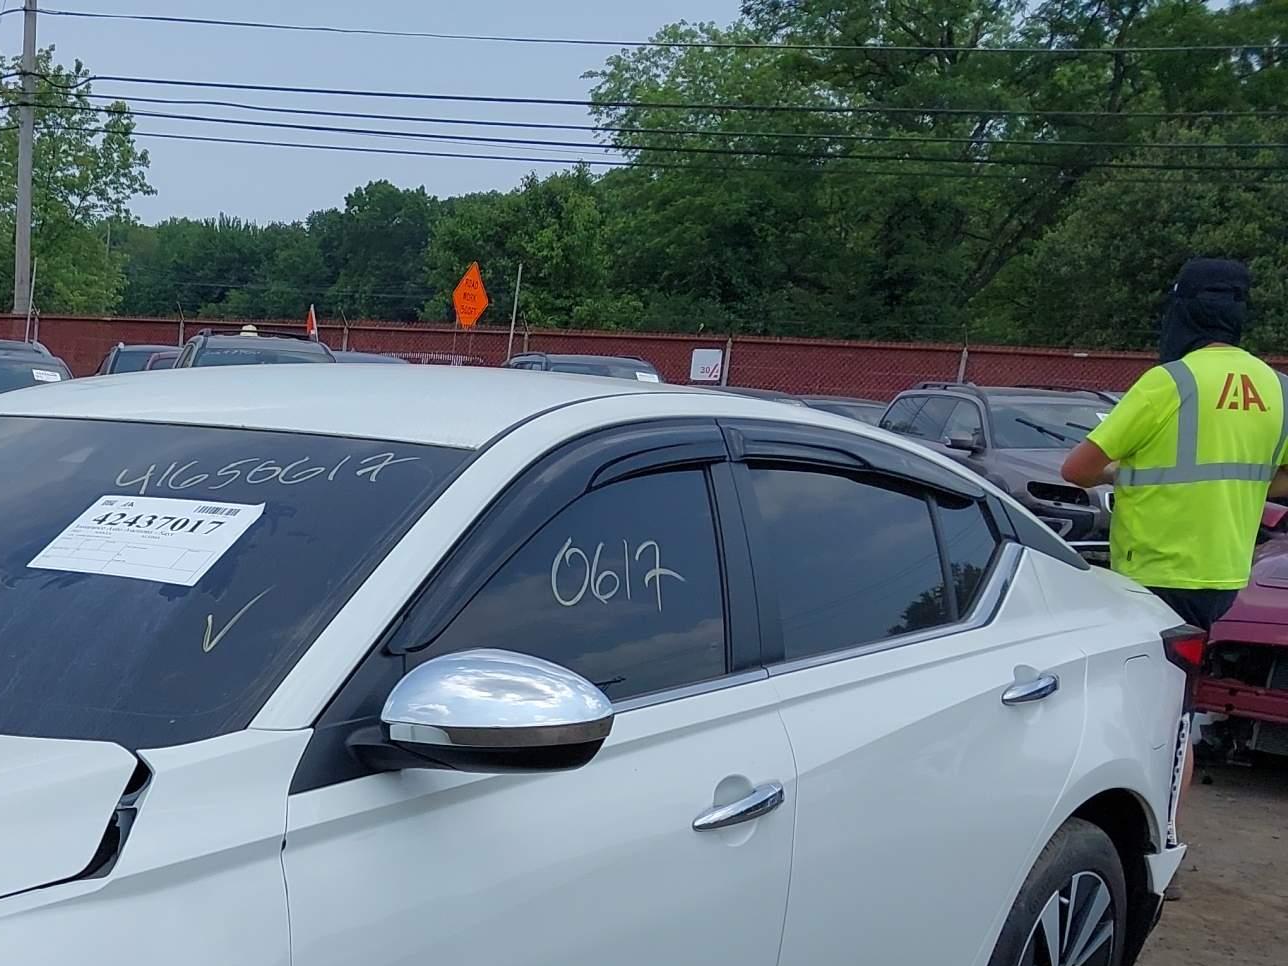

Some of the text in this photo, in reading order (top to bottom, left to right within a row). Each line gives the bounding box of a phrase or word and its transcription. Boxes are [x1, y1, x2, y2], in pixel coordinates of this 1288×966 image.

[465, 278, 479, 290] ROAD
[92, 512, 226, 535] 42437017
[551, 536, 687, 613] 0617
